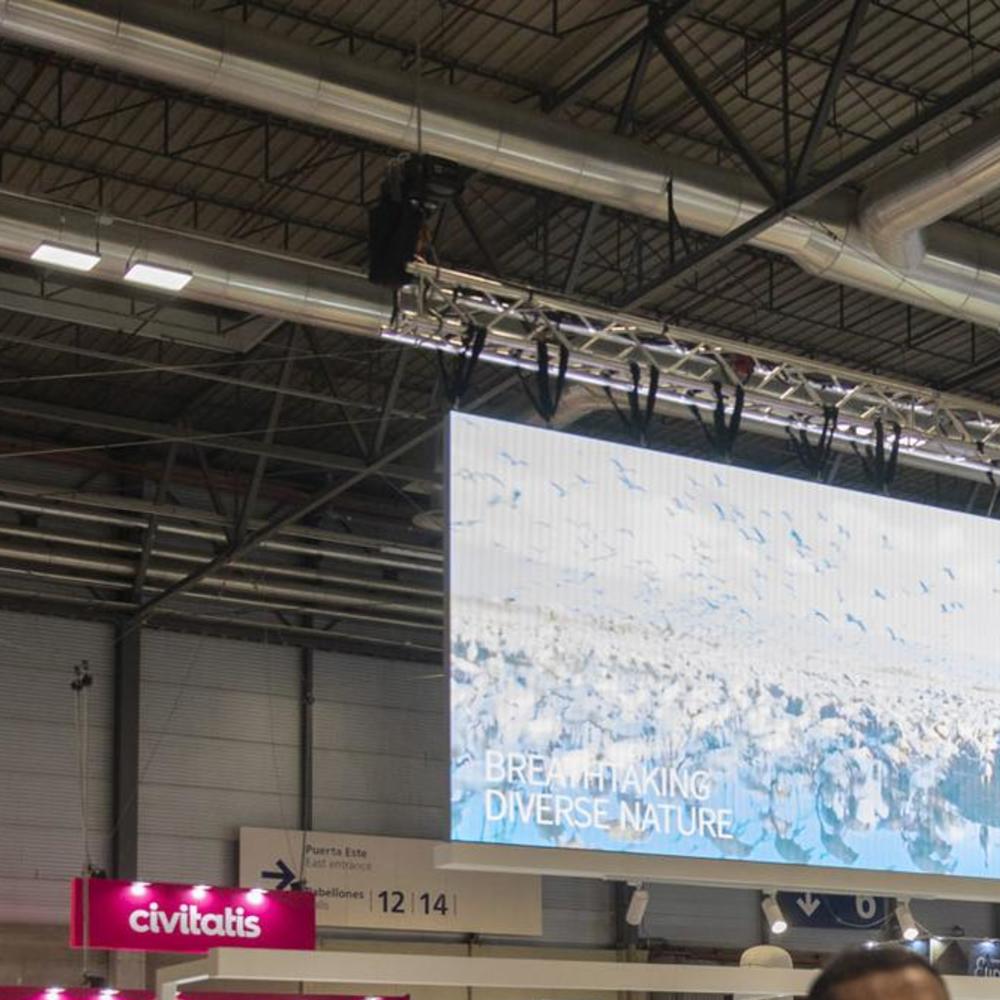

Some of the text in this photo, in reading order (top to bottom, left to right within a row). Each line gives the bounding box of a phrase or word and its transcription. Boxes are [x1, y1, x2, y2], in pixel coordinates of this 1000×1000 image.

[485, 750, 712, 801] BREATHTAKING
[485, 788, 734, 840] DIVERSE NATURE
[305, 844, 368, 858] Puerta Este
[128, 902, 262, 939] civitatis
[377, 891, 405, 914] 12
[419, 892, 449, 915] 14
